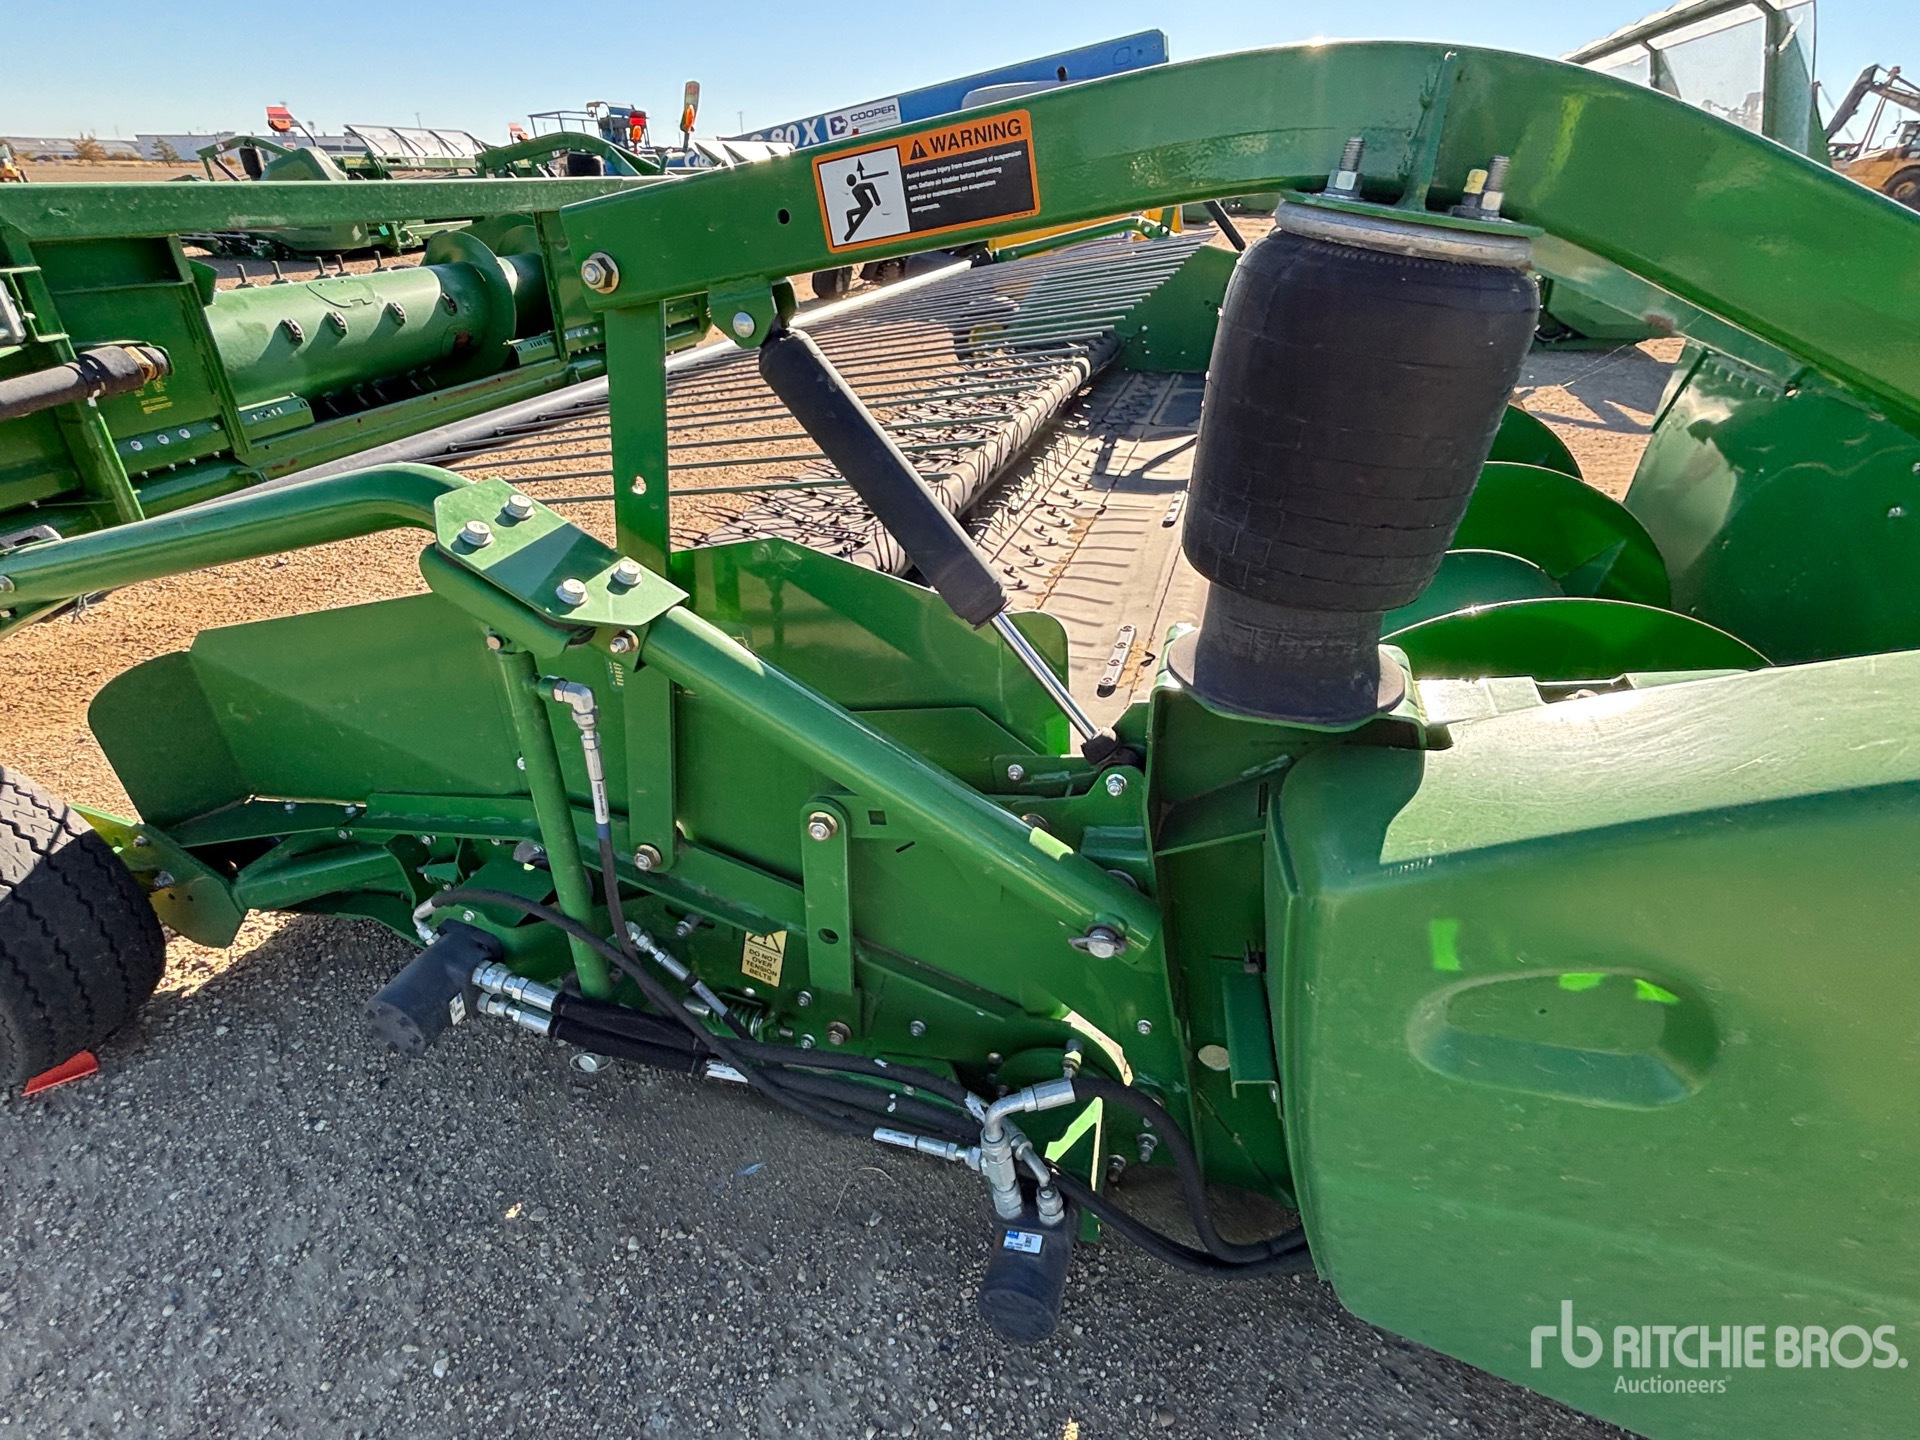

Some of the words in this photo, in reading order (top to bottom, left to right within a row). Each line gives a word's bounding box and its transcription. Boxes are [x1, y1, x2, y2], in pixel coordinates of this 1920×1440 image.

[850, 104, 896, 122] COOPER
[929, 118, 1022, 154] WARNING
[906, 171, 920, 180] Avoid
[937, 165, 951, 174] injury
[951, 162, 963, 170] from
[749, 948, 760, 957] DO
[762, 954, 777, 963] NOT
[752, 956, 772, 968] OVER
[746, 960, 777, 976] TENSION
[749, 968, 772, 981] BELTS
